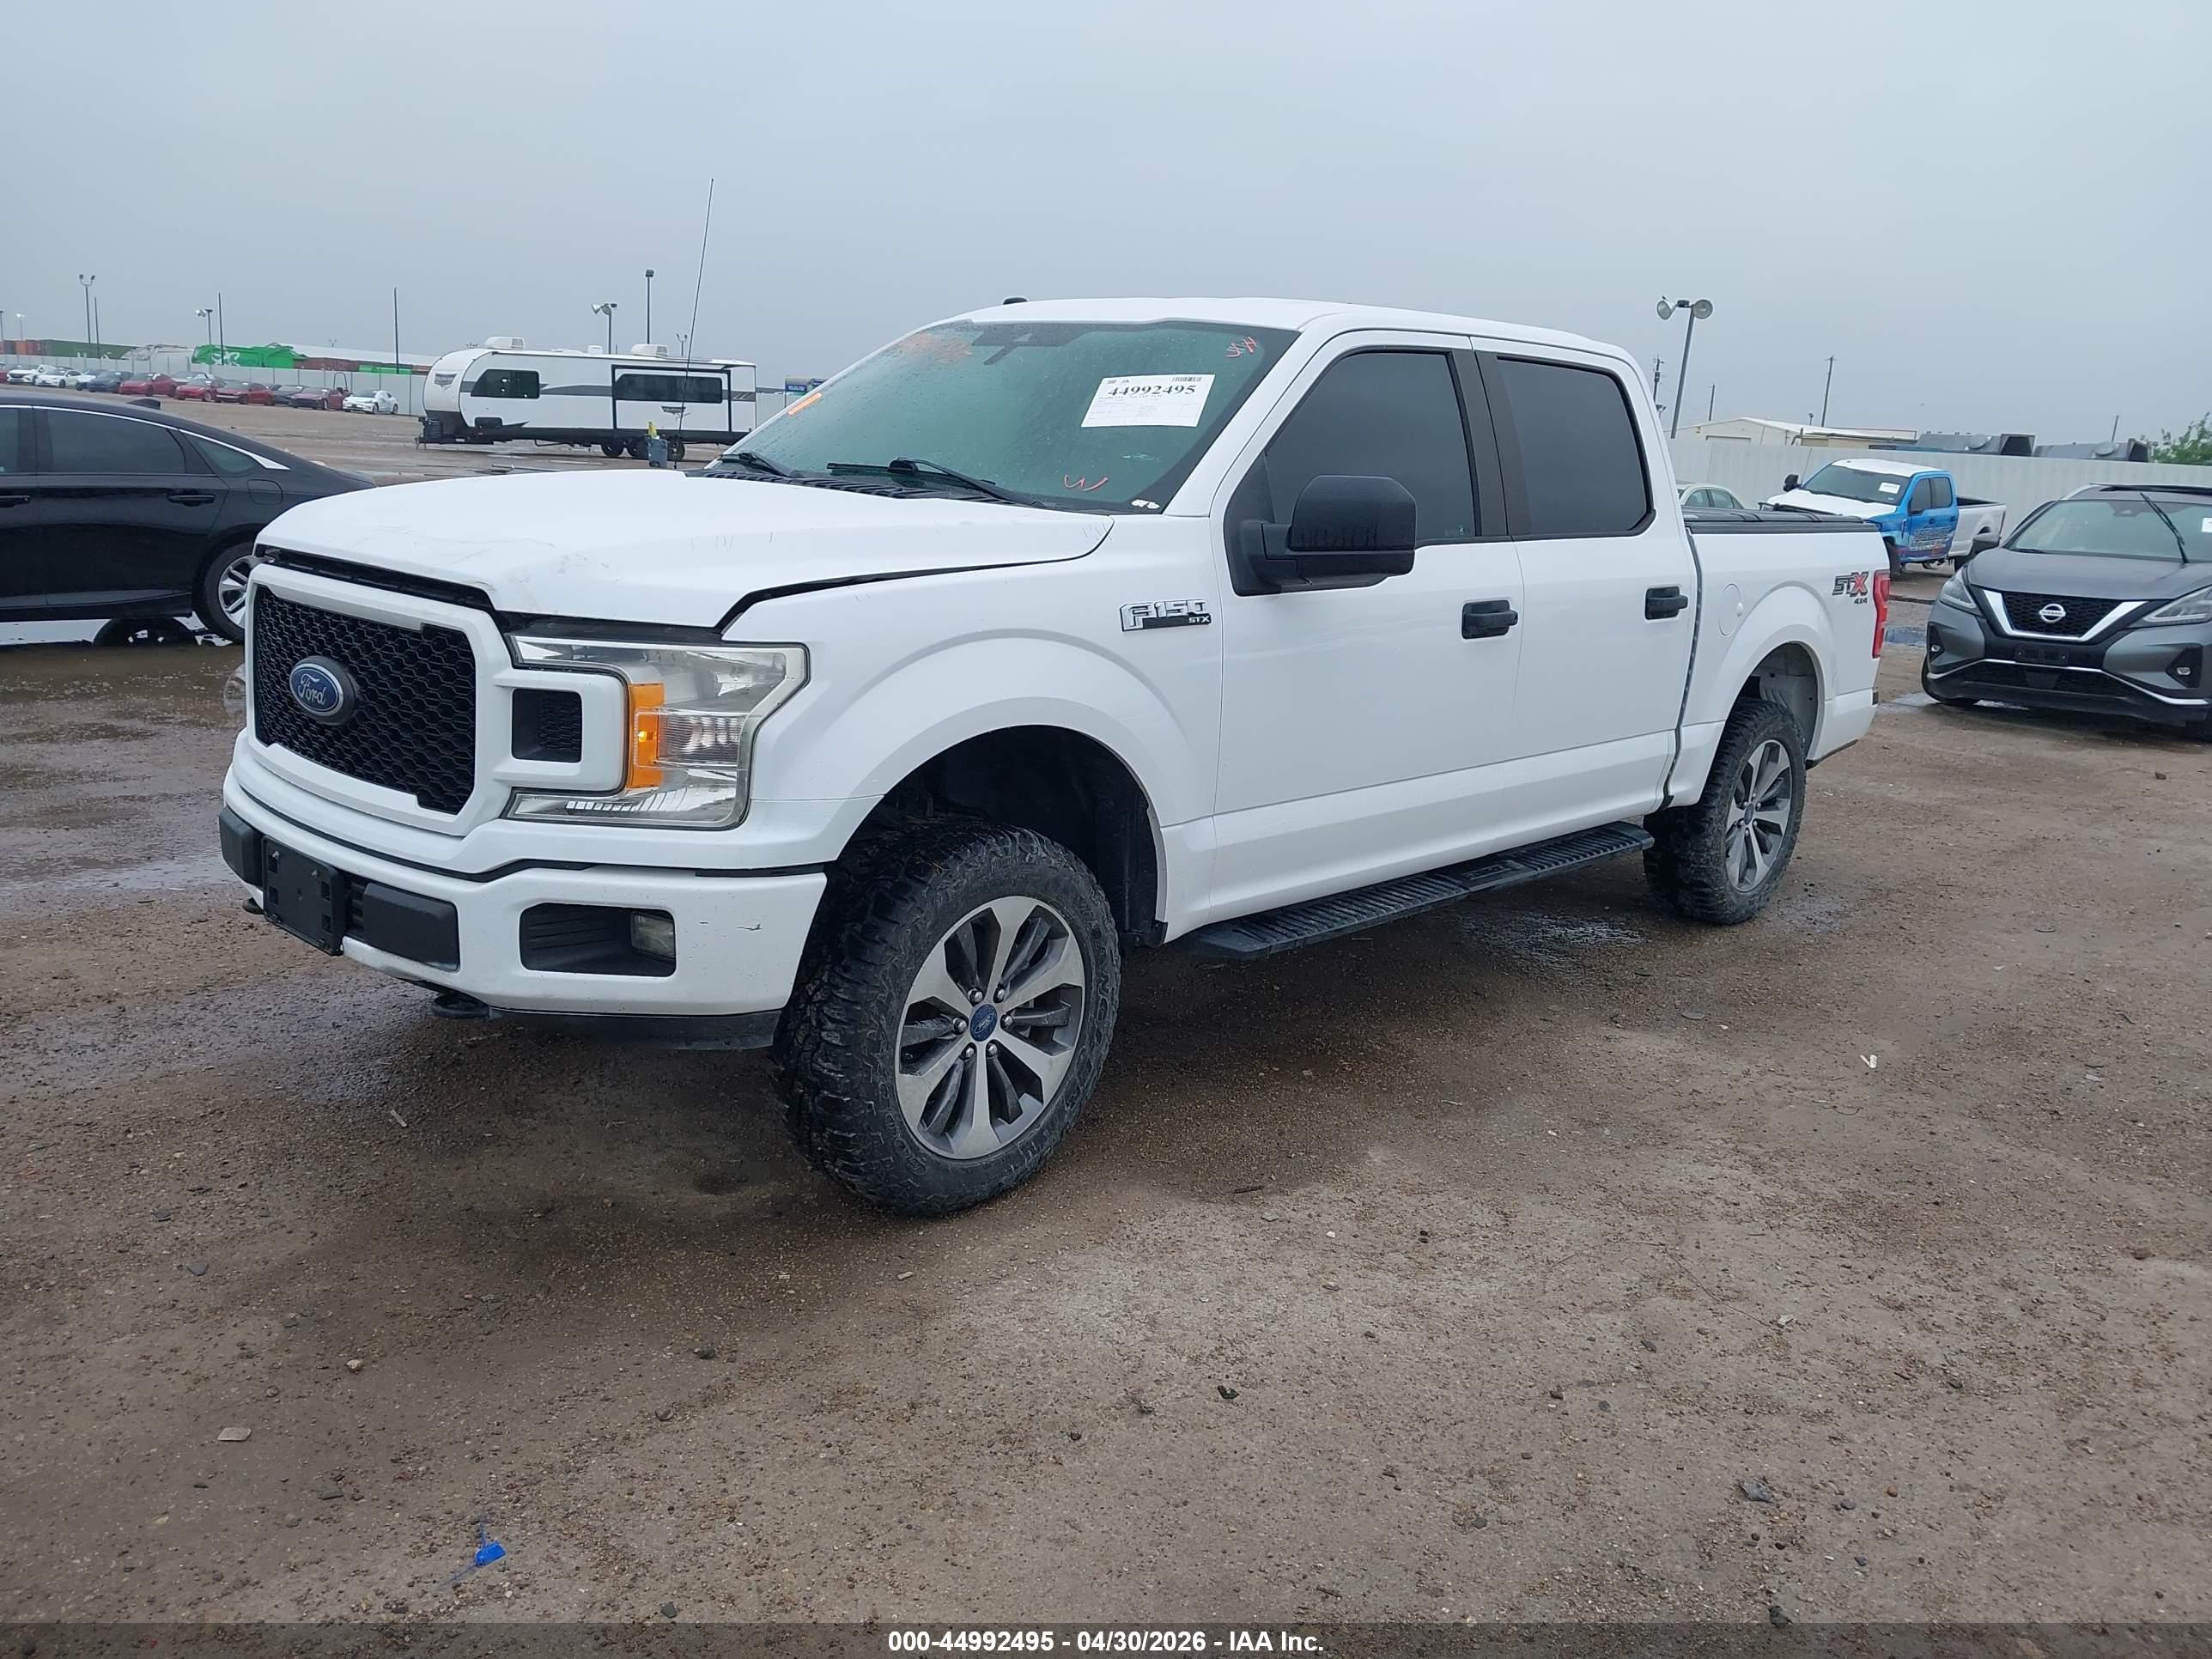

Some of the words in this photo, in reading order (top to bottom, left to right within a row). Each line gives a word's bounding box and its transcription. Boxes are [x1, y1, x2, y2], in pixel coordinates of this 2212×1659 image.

[1108, 385, 1197, 396] 44992495
[1832, 571, 1869, 597] STX
[297, 673, 327, 705] Ford
